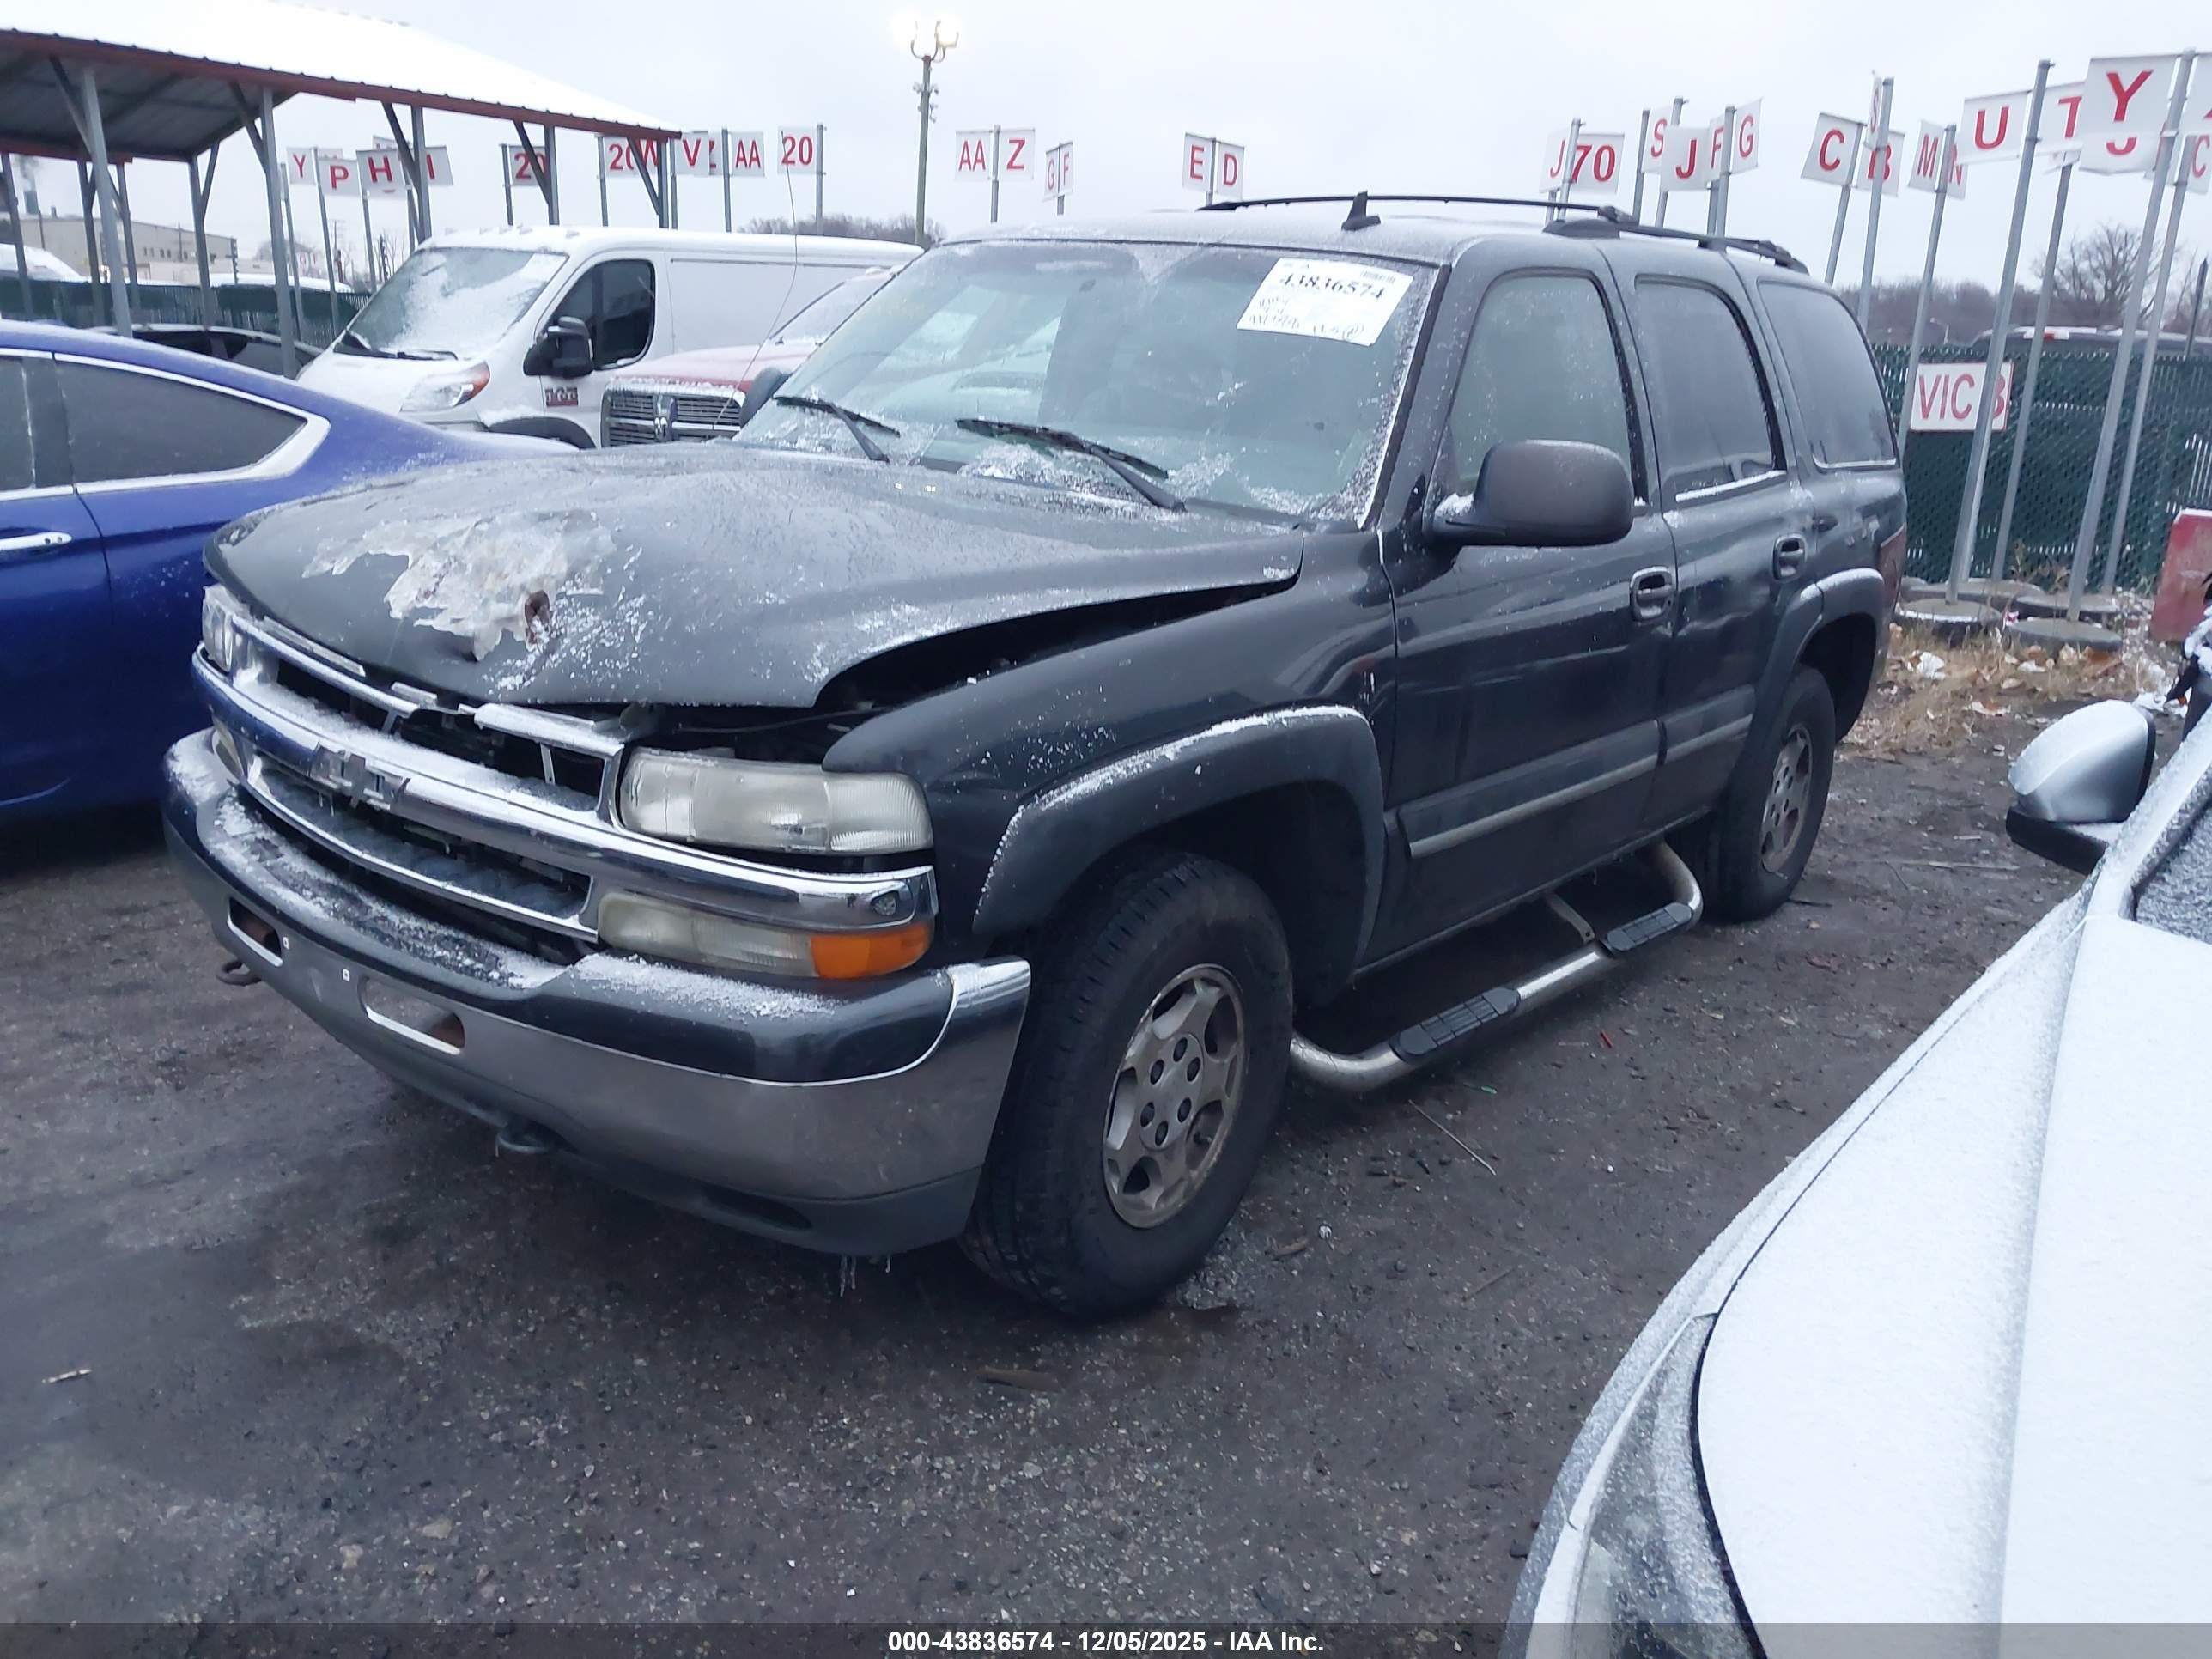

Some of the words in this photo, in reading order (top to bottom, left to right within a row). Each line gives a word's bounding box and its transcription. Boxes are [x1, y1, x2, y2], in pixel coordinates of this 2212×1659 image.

[2106, 69, 2154, 122] Y
[1974, 106, 2009, 150] U
[2058, 96, 2083, 138] T
[683, 138, 702, 167] V
[735, 139, 761, 168] AA
[781, 135, 813, 166] 20
[958, 140, 987, 171] AA
[1006, 138, 1026, 170] Z
[1650, 118, 1668, 158] S
[1738, 115, 1754, 158] G
[1818, 128, 1845, 171] C
[293, 154, 306, 179] Y
[367, 155, 393, 184] H
[1047, 159, 1055, 191] G
[1189, 144, 1205, 180] E
[1222, 153, 1238, 186] D
[1549, 139, 1565, 178] J
[1571, 144, 1616, 182] 70
[1675, 139, 1698, 179] J
[1917, 134, 1939, 179] M
[2192, 135, 2210, 179] C
[329, 165, 349, 190] P
[1918, 374, 1975, 420] VIC
